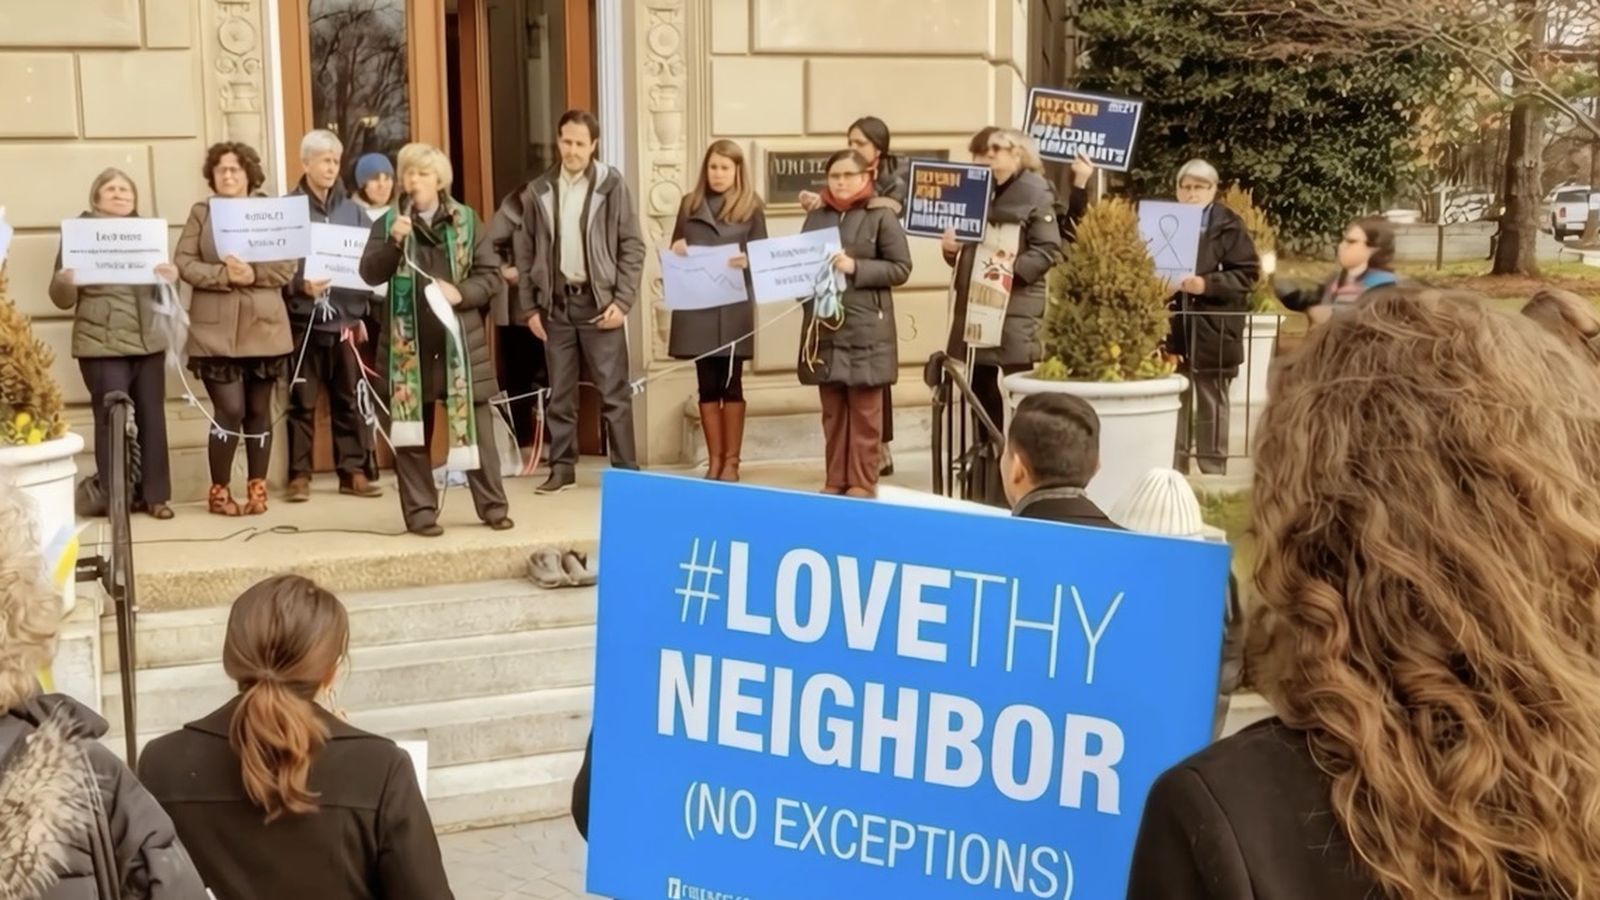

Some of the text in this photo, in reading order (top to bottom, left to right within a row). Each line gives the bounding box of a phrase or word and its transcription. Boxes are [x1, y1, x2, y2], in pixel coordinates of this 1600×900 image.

[775, 158, 826, 176] UNITE
[657, 647, 1126, 816] NEIGHBOR
[685, 781, 1075, 900] (NO EXCEPTIONS)
